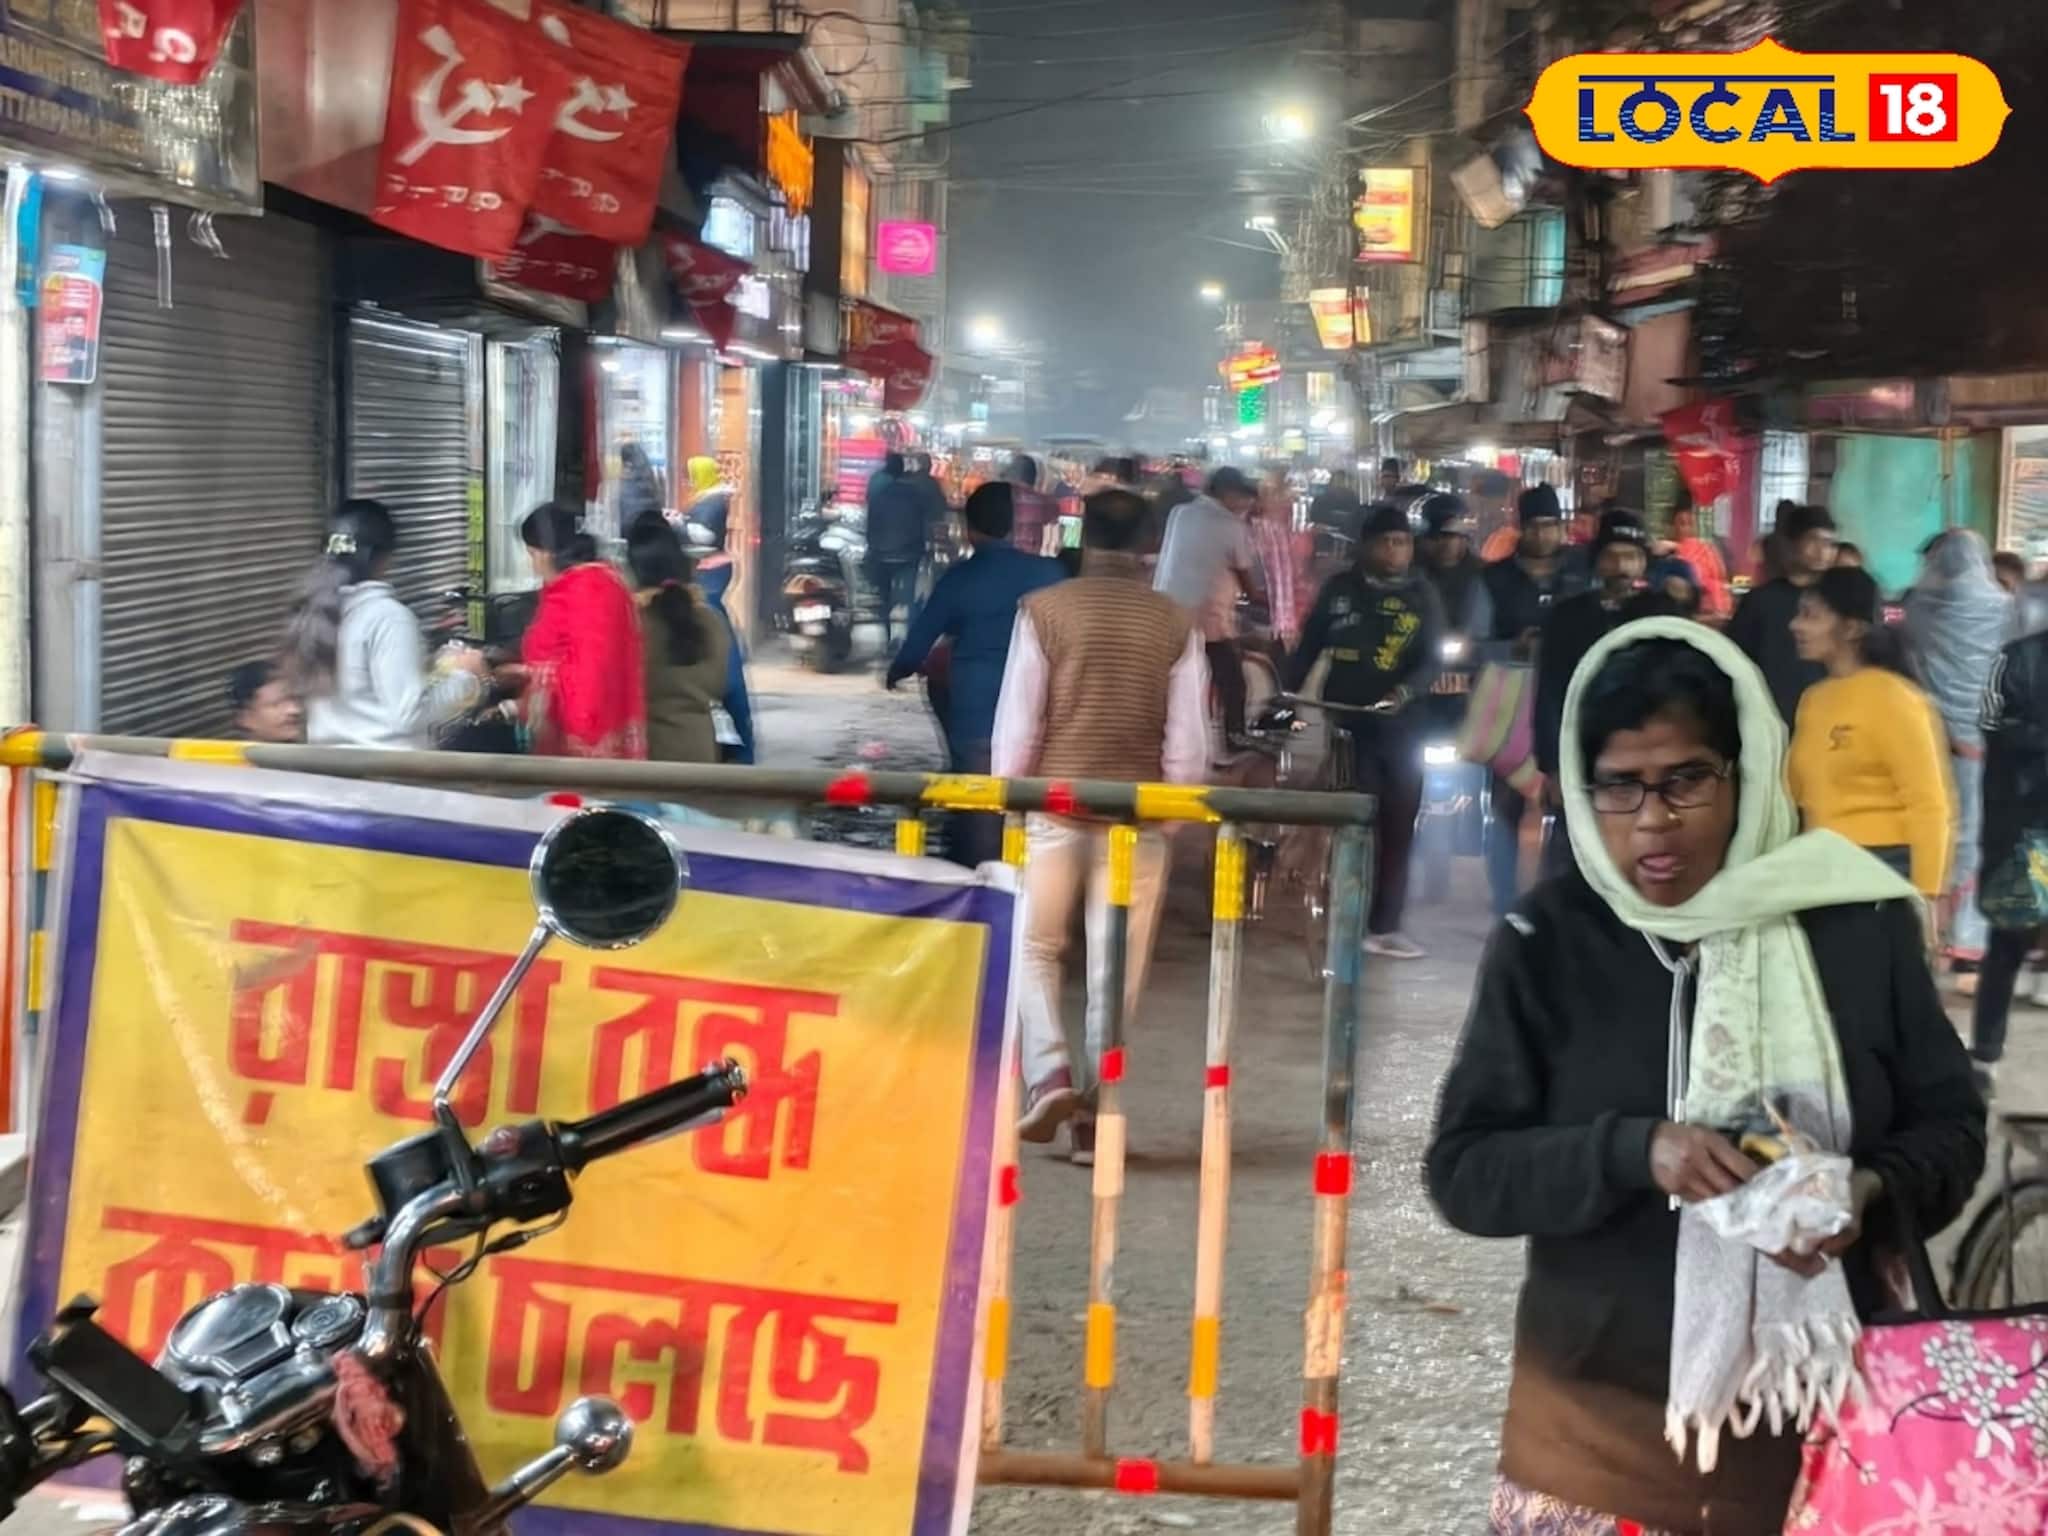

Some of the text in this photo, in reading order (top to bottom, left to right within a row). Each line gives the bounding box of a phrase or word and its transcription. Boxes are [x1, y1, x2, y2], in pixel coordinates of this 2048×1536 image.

[229, 918, 842, 1181] রাস্তা বন্ধ
[486, 1254, 899, 1474] চলছে
